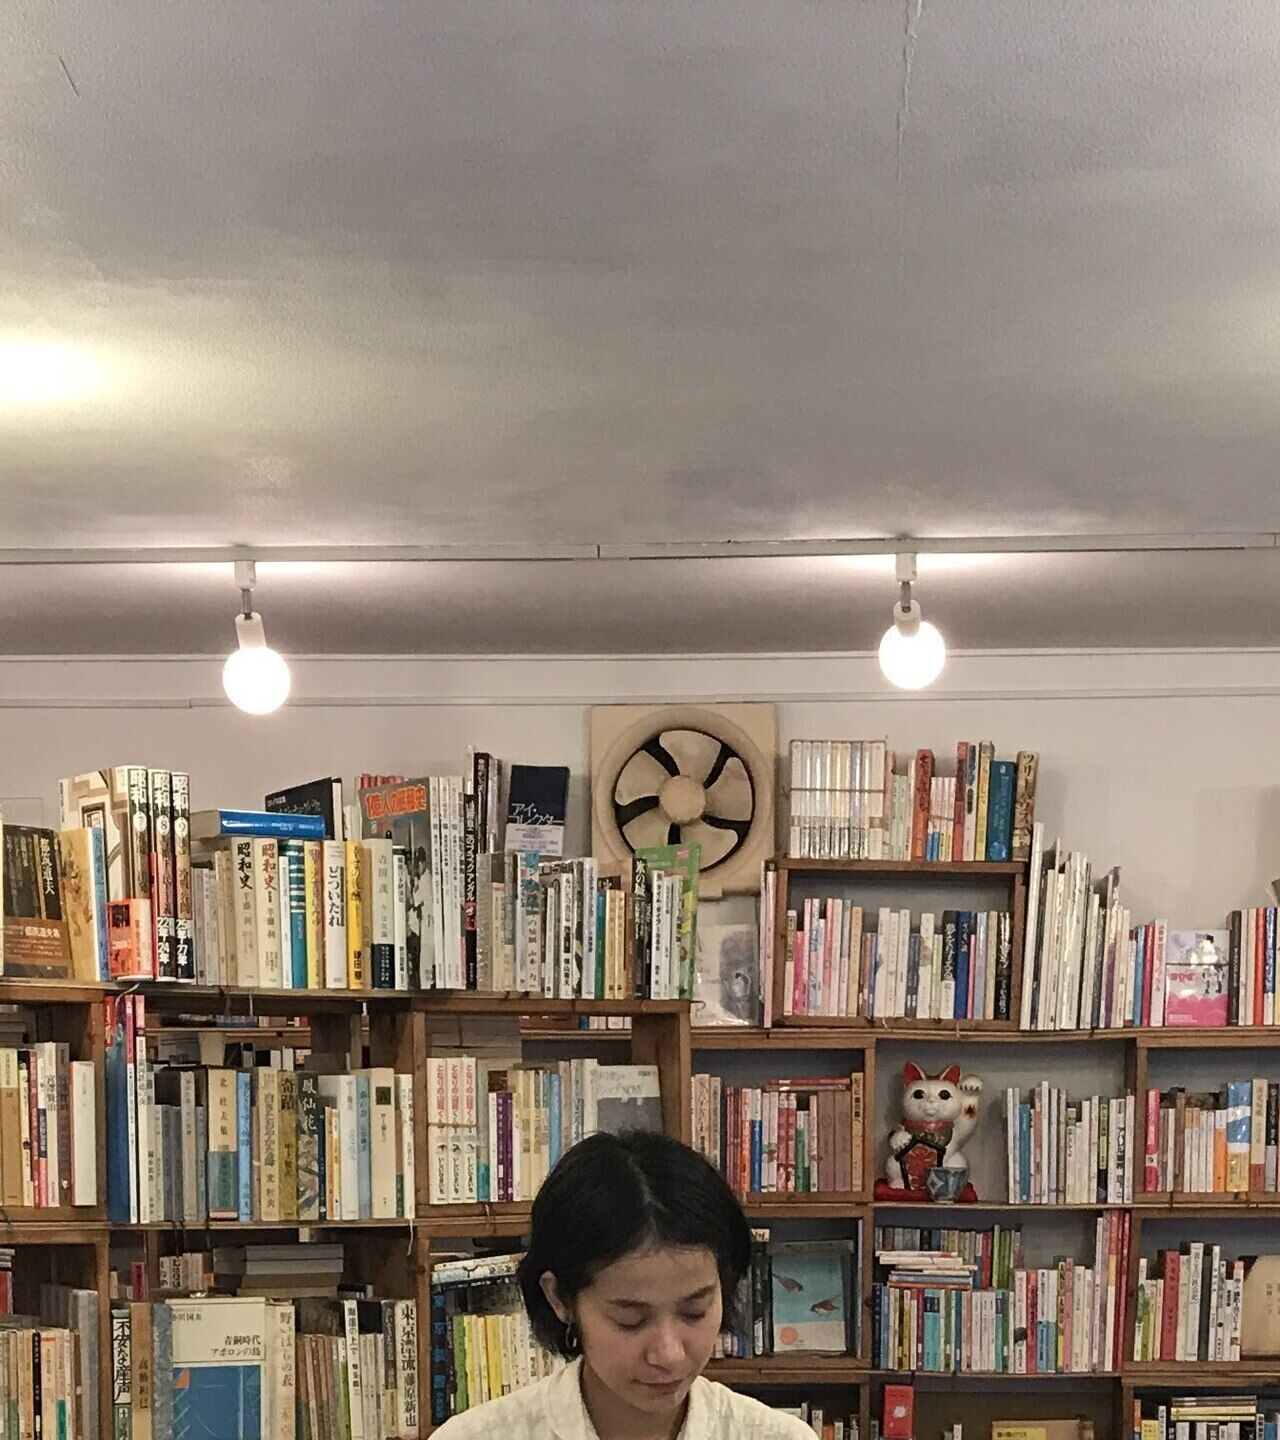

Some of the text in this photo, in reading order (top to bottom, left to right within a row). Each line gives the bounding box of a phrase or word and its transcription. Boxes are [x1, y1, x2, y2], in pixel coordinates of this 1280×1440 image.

[129, 768, 147, 811] 昭和
[154, 772, 170, 806] 昭和
[173, 773, 188, 813] 昭和
[237, 842, 254, 889] 昭和史
[260, 842, 277, 891] 昭和史
[400, 1303, 416, 1372] 東京漂流
